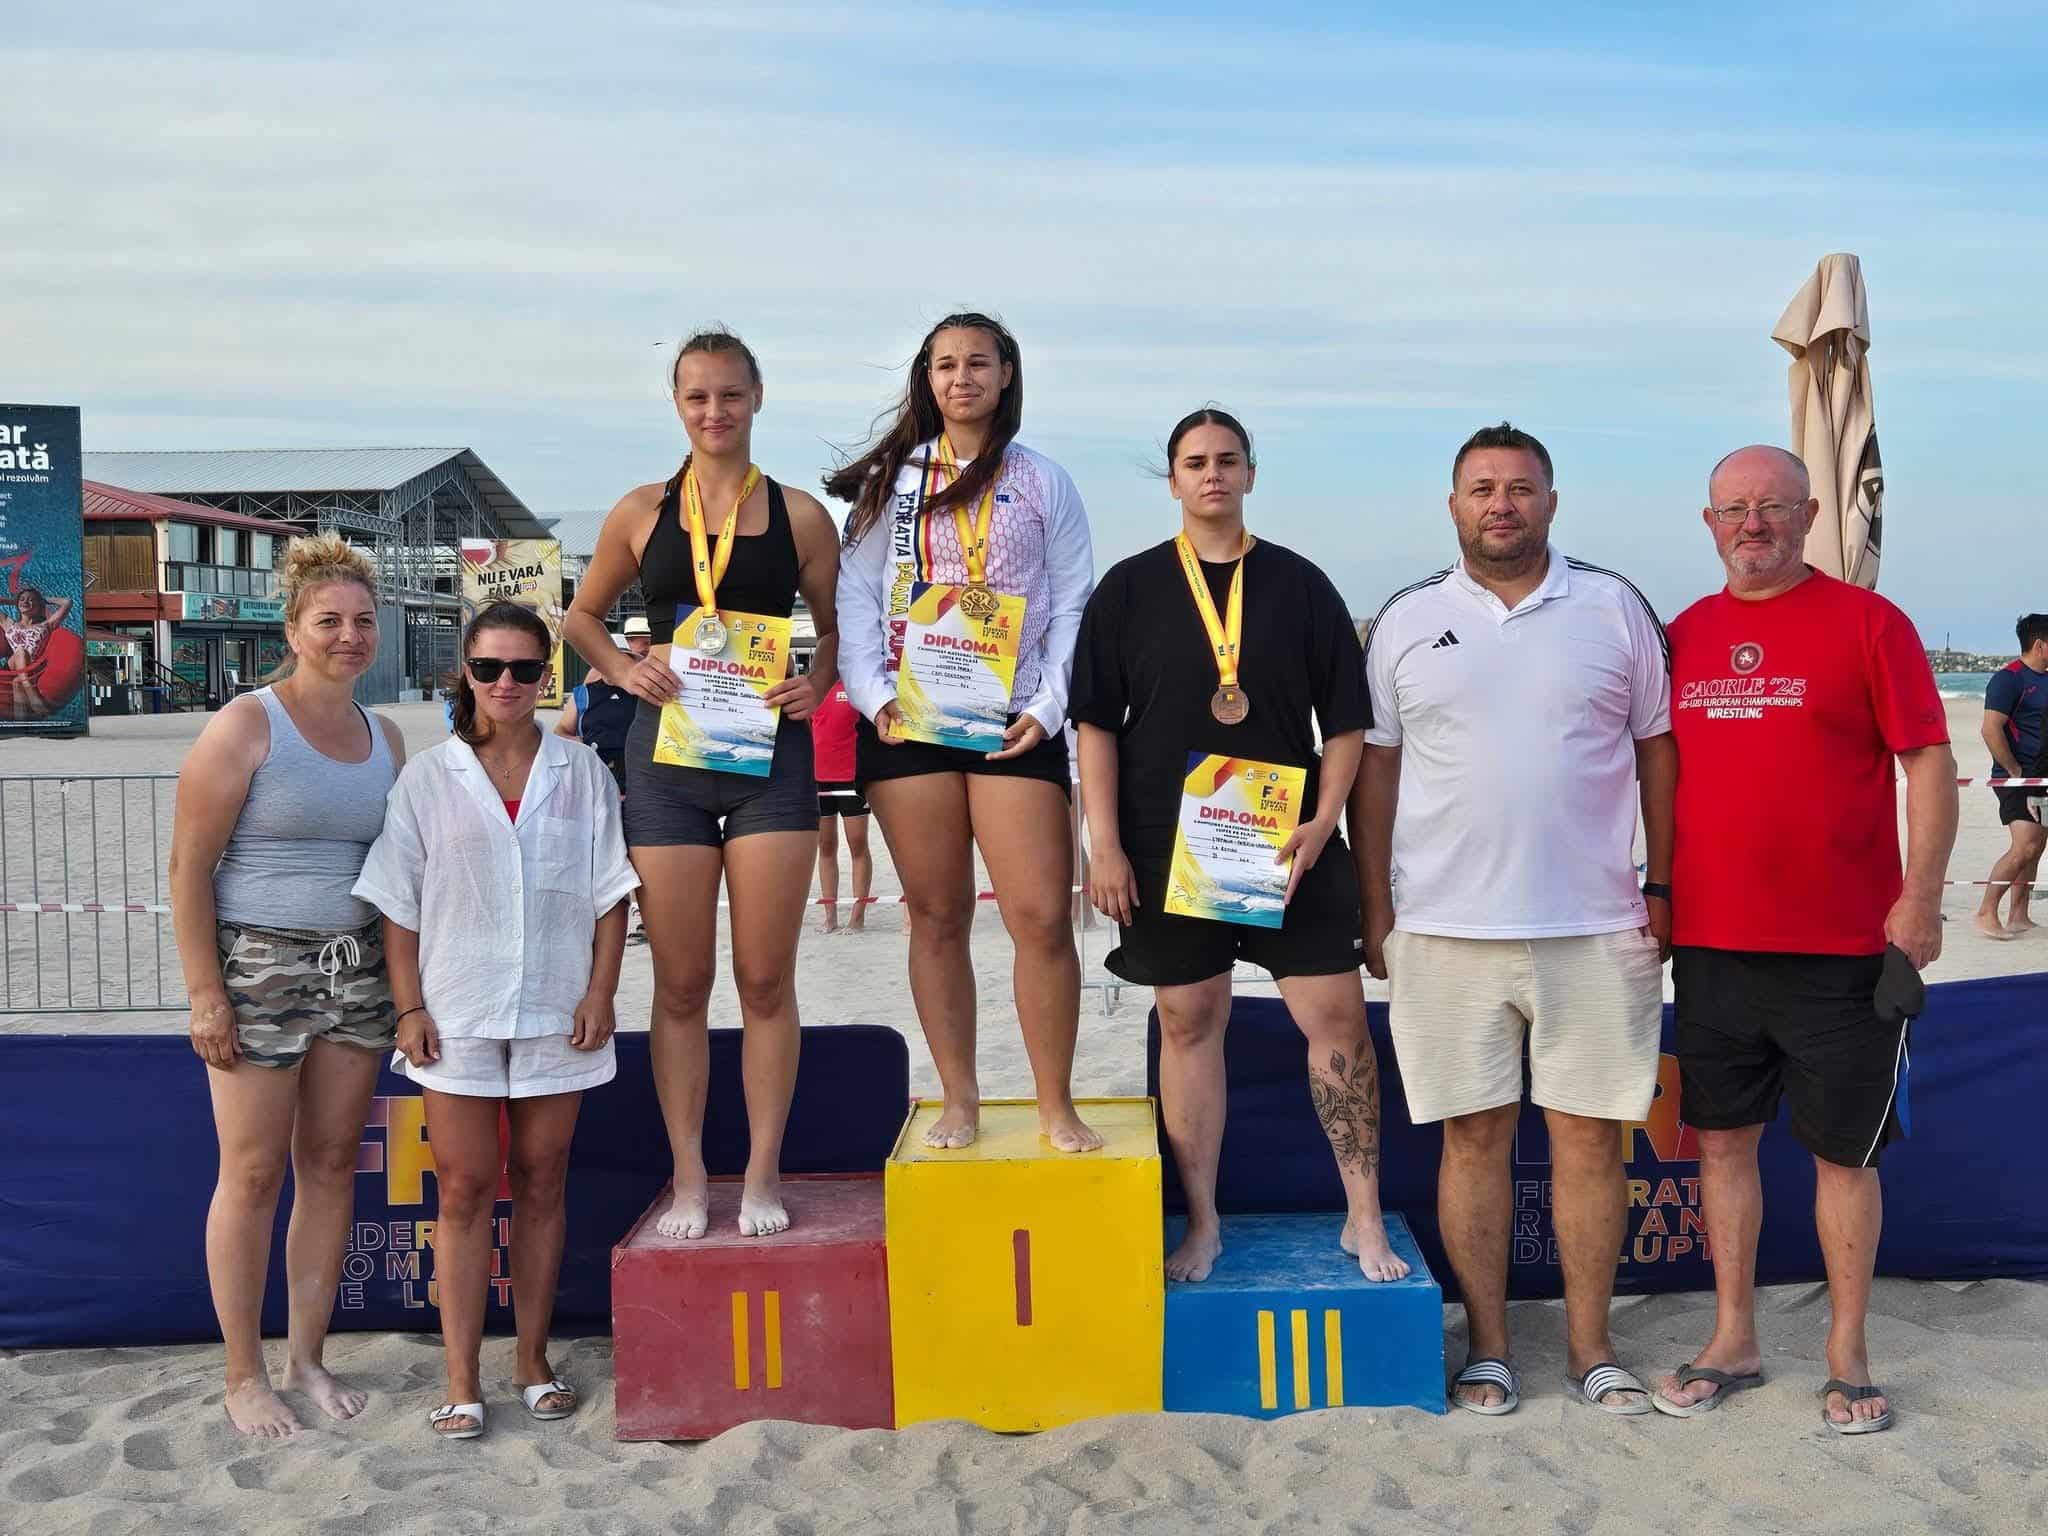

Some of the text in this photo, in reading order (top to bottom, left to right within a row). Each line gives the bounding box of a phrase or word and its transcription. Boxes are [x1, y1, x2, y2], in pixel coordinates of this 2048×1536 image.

[478, 572, 496, 586] NU
[499, 571, 506, 582] E
[923, 633, 1000, 656] DIPLOMA
[688, 656, 766, 679] DIPLOMA
[1703, 697, 1741, 707] EUROPEAN
[1742, 697, 1803, 707] CHAMPIONSHIPS
[1707, 707, 1763, 719] WRESTLING
[1200, 806, 1278, 829] DIPLOMA
